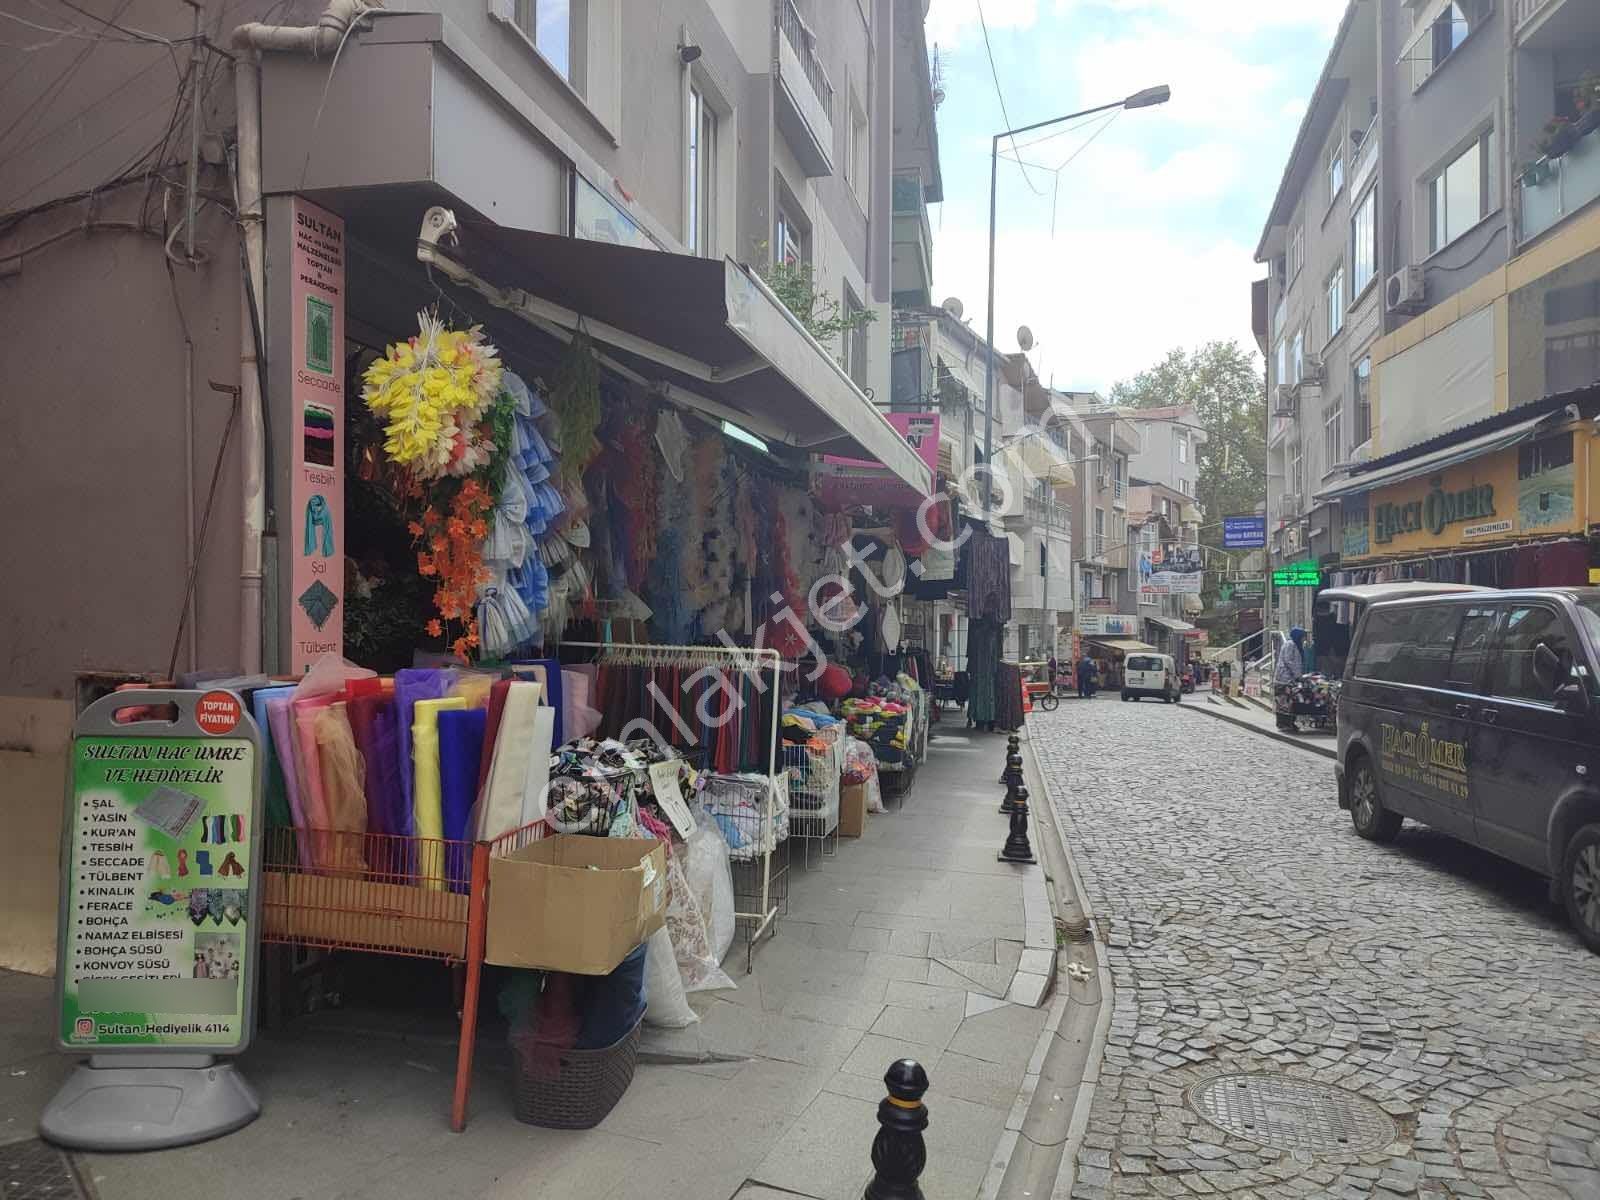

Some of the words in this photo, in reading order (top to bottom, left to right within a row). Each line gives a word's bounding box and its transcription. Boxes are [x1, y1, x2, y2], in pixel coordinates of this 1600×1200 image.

[297, 213, 341, 243] SULTAN
[298, 231, 313, 243] HAC
[306, 257, 333, 275] TOPTAN
[297, 369, 341, 392] Seccade
[304, 469, 336, 487] Tesbih
[1422, 478, 1496, 535] ÖMER
[311, 562, 327, 575] Şal
[296, 641, 337, 655] Tülbent
[203, 701, 234, 712] TOPTAN
[200, 713, 235, 725] FİYATINA
[84, 744, 153, 760] SULTAN
[156, 746, 192, 760] HAC
[194, 746, 247, 760] UMRE
[1416, 720, 1467, 772] ÖMER
[105, 768, 130, 783] VE
[133, 765, 224, 784] HEDİYELİK
[91, 799, 115, 810] ŞAL
[91, 812, 127, 822] YASİN
[90, 828, 136, 838] KUR'AN
[90, 840, 133, 852] TESBİH
[88, 857, 144, 867] SECCADE
[88, 870, 144, 881] TÜLBENT
[87, 887, 135, 897] KINALIK
[86, 902, 133, 911] FERACE
[86, 917, 128, 928] BOHÇA
[85, 931, 129, 940] NAMAZ
[131, 929, 183, 940] ELBİSESİ
[84, 946, 126, 957] BOHÇA
[129, 944, 162, 955] SÜSÜ
[83, 961, 135, 970] KONVOY
[137, 959, 170, 969] SÜSÜ
[204, 1024, 230, 1034] 4114
